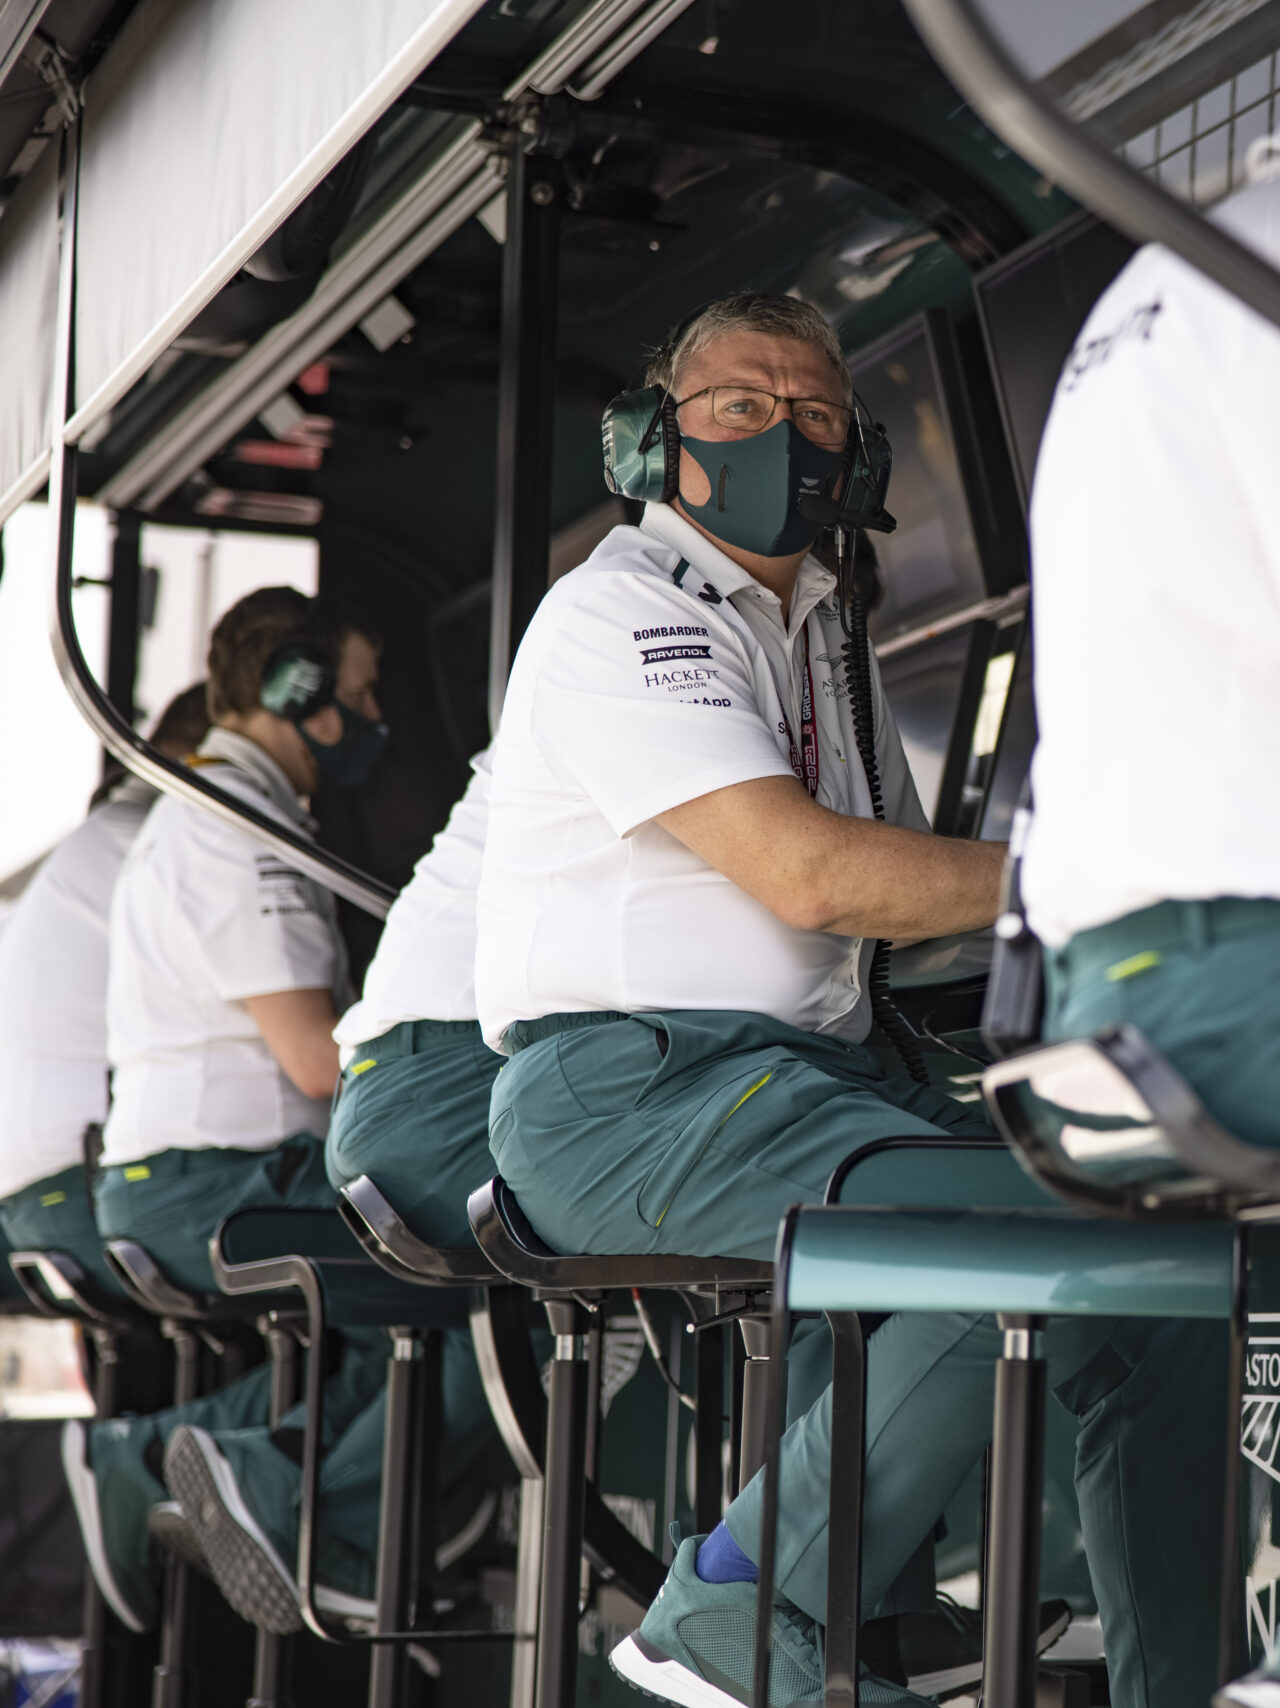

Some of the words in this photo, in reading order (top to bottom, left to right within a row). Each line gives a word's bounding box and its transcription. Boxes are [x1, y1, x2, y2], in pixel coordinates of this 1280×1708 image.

[633, 626, 709, 641] BOMBARDIER
[647, 648, 707, 660] RAVENOL
[645, 668, 719, 687] HACKETT
[667, 682, 708, 692] LONDON
